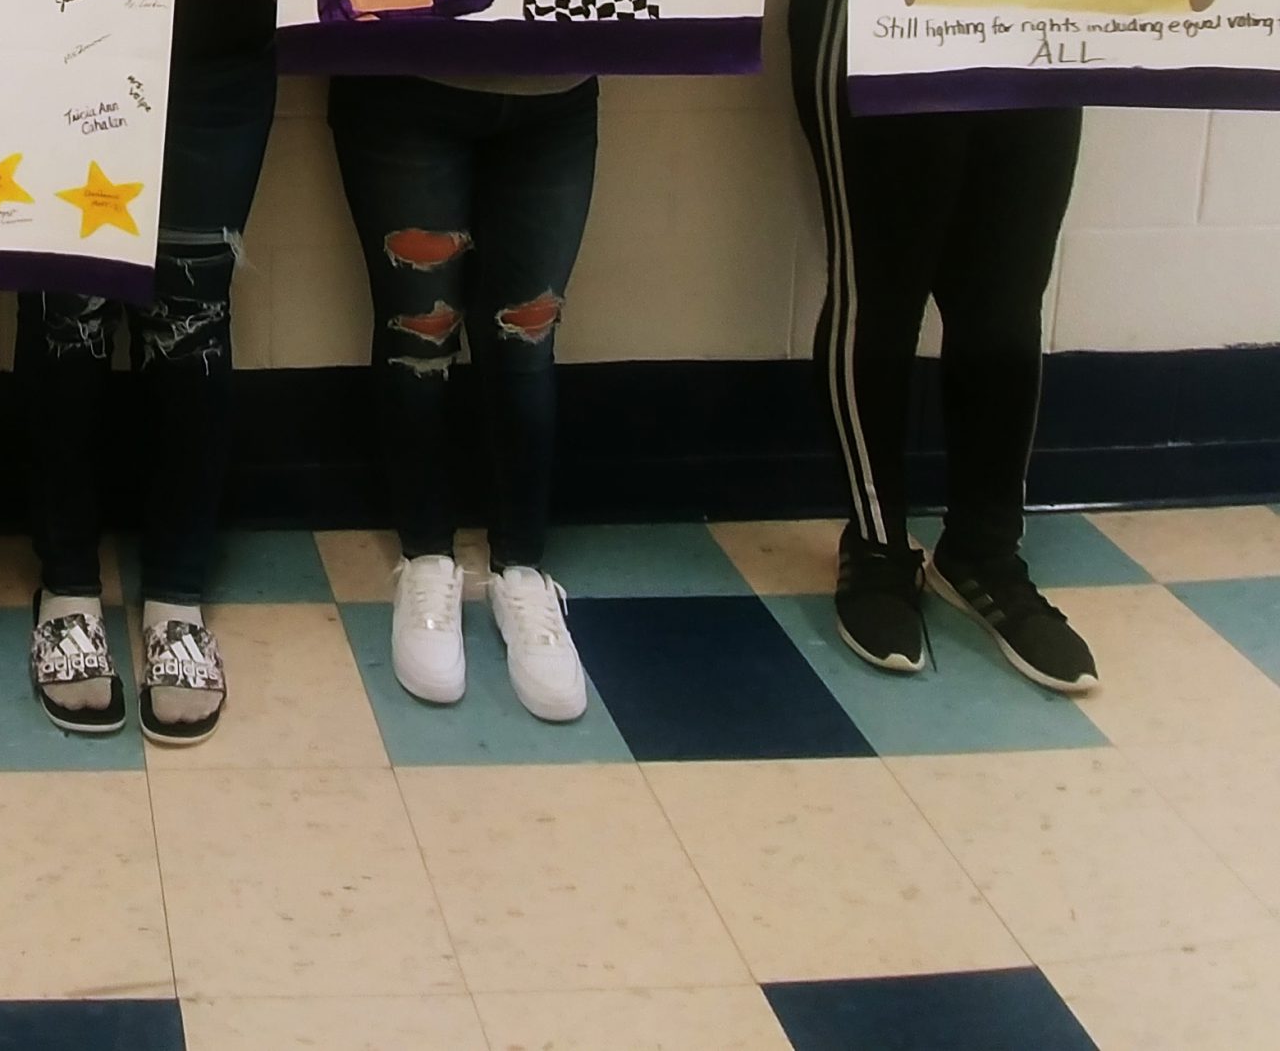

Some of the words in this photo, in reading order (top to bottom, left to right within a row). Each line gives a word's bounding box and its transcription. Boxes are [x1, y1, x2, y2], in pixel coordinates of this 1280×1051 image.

[873, 16, 919, 39] Still
[1021, 16, 1081, 42] rights
[1087, 17, 1164, 40] including
[1168, 15, 1222, 38] equal
[1028, 40, 1107, 67] ALL
[42, 652, 109, 676] adidas
[152, 658, 220, 682] adidas
